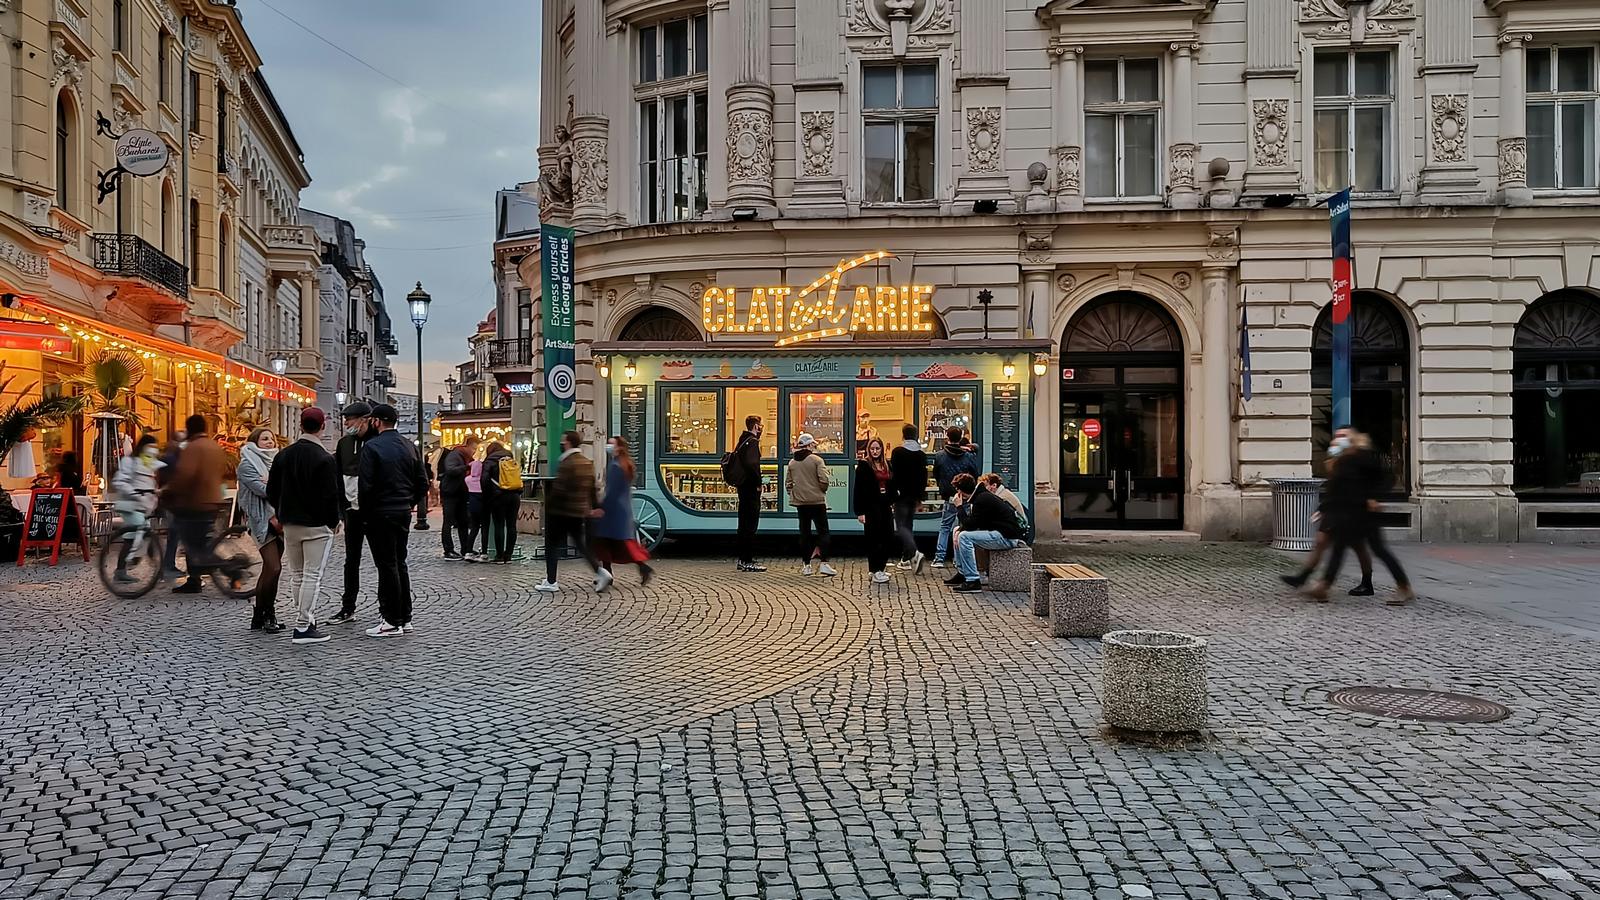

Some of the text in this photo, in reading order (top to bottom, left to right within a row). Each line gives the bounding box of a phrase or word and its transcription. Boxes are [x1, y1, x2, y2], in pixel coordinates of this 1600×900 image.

[129, 136, 152, 148] Little
[117, 144, 160, 157] Bucharest
[549, 235, 561, 326] Express yourself
[560, 238, 571, 327] in George Circles
[545, 339, 557, 348] Art
[925, 406, 947, 416] Collect
[926, 429, 948, 438] Thank
